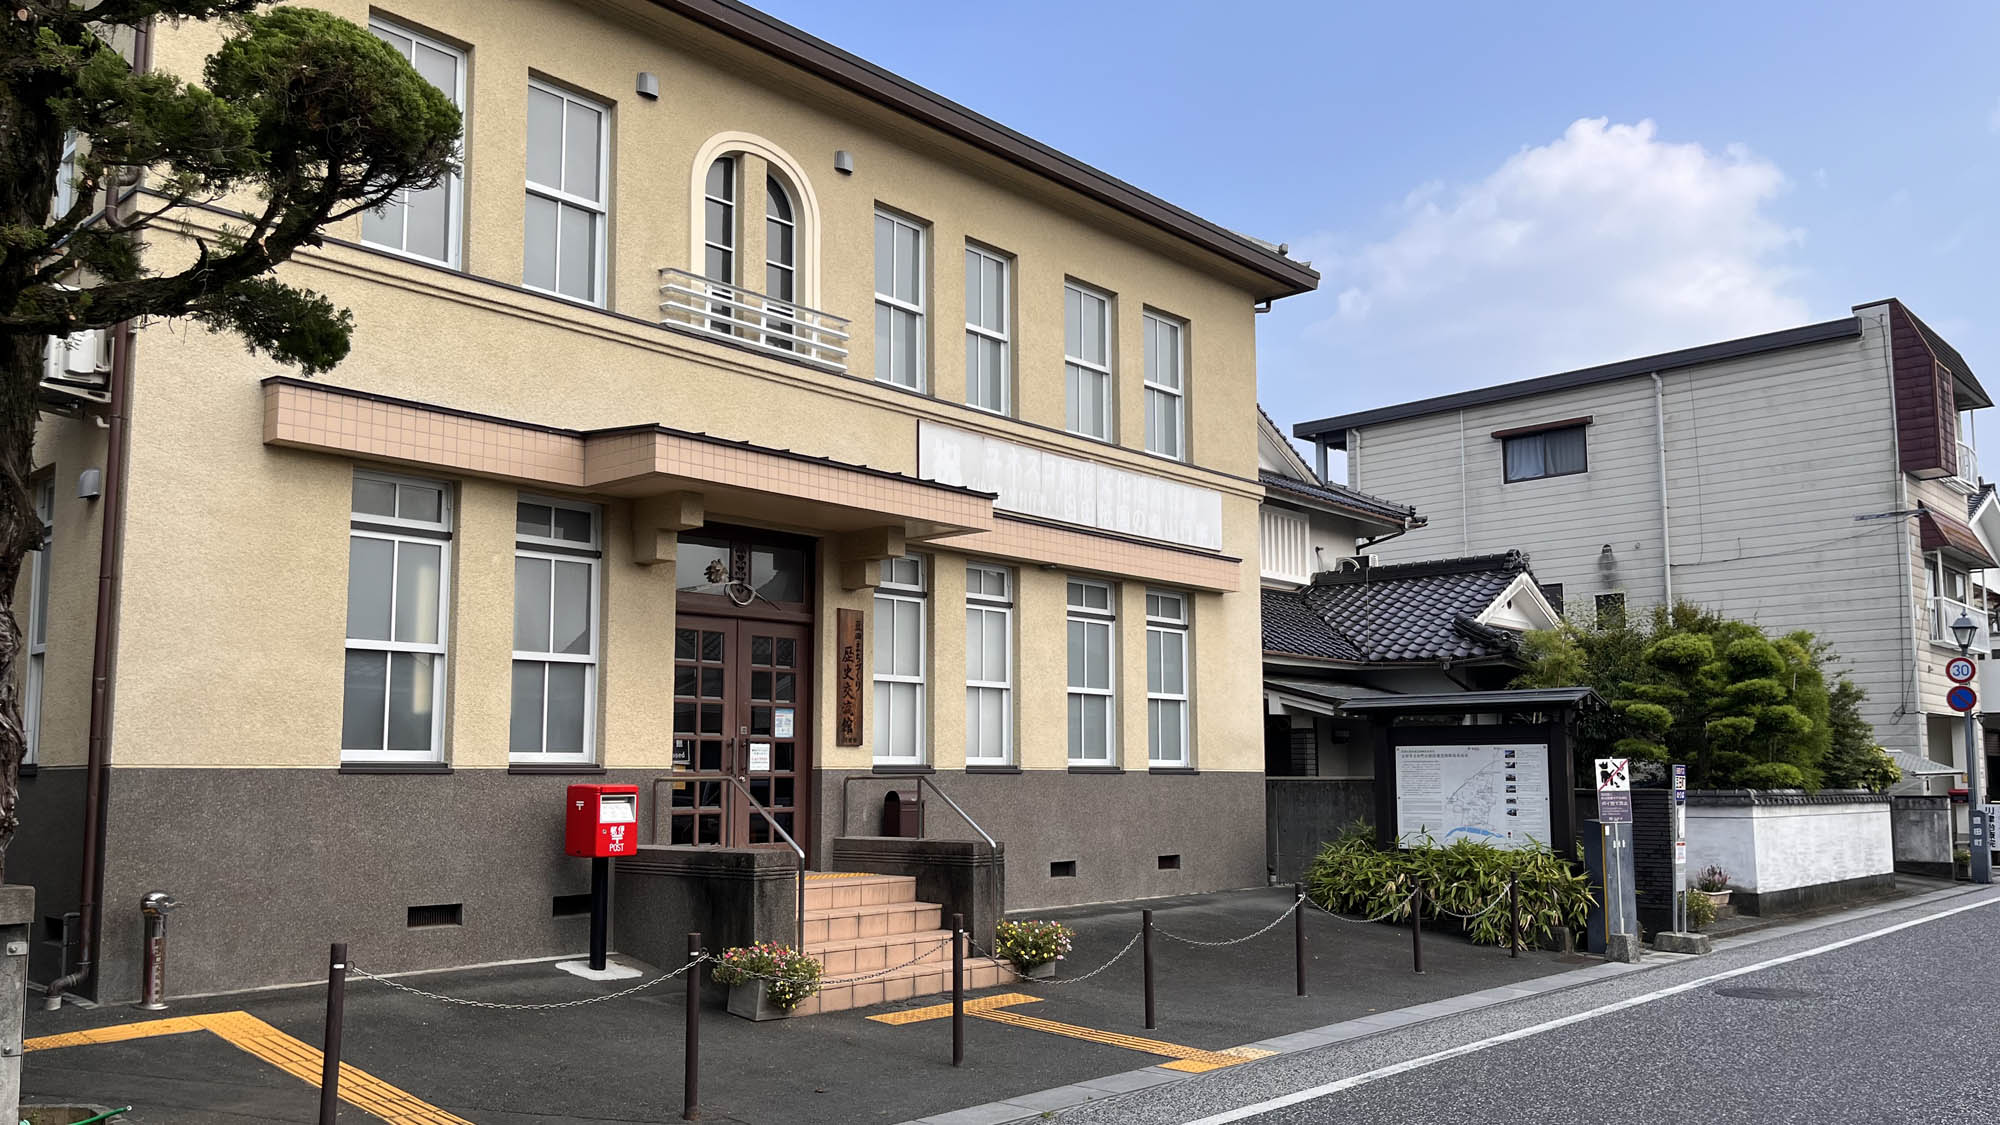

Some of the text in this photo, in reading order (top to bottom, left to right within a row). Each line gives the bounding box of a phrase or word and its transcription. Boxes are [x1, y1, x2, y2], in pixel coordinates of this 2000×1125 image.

[1952, 664, 1970, 677] 30
[842, 646, 855, 734] 歴史交流館
[610, 825, 624, 835] 郵便
[609, 843, 624, 852] POST
